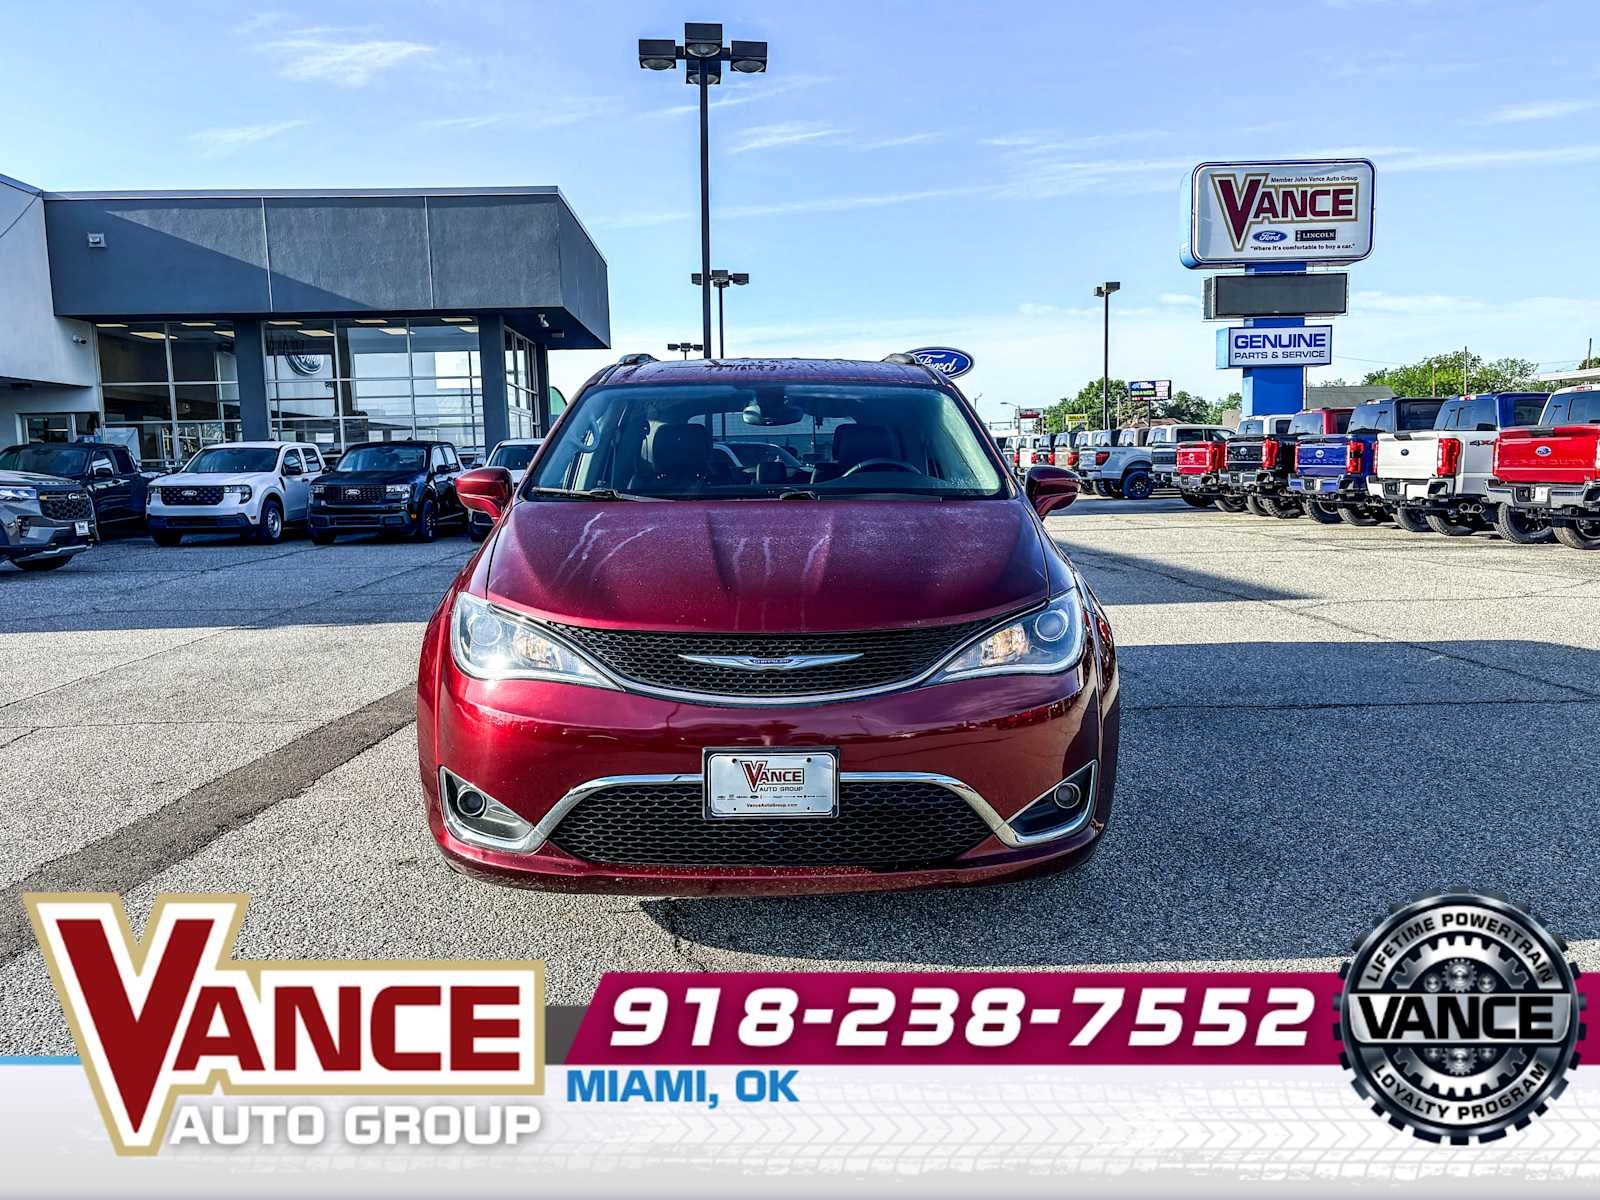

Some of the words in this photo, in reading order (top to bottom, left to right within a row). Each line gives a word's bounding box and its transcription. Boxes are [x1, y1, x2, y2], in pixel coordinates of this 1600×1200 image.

[1217, 178, 1354, 246] VANCE
[1259, 231, 1281, 241] Ford
[1302, 231, 1335, 239] LINCOLN
[1234, 333, 1326, 349] GENUINE
[1234, 351, 1268, 359] PARTS
[1271, 351, 1278, 359] &
[1282, 350, 1325, 358] SERVICE
[742, 761, 803, 791] VANCE
